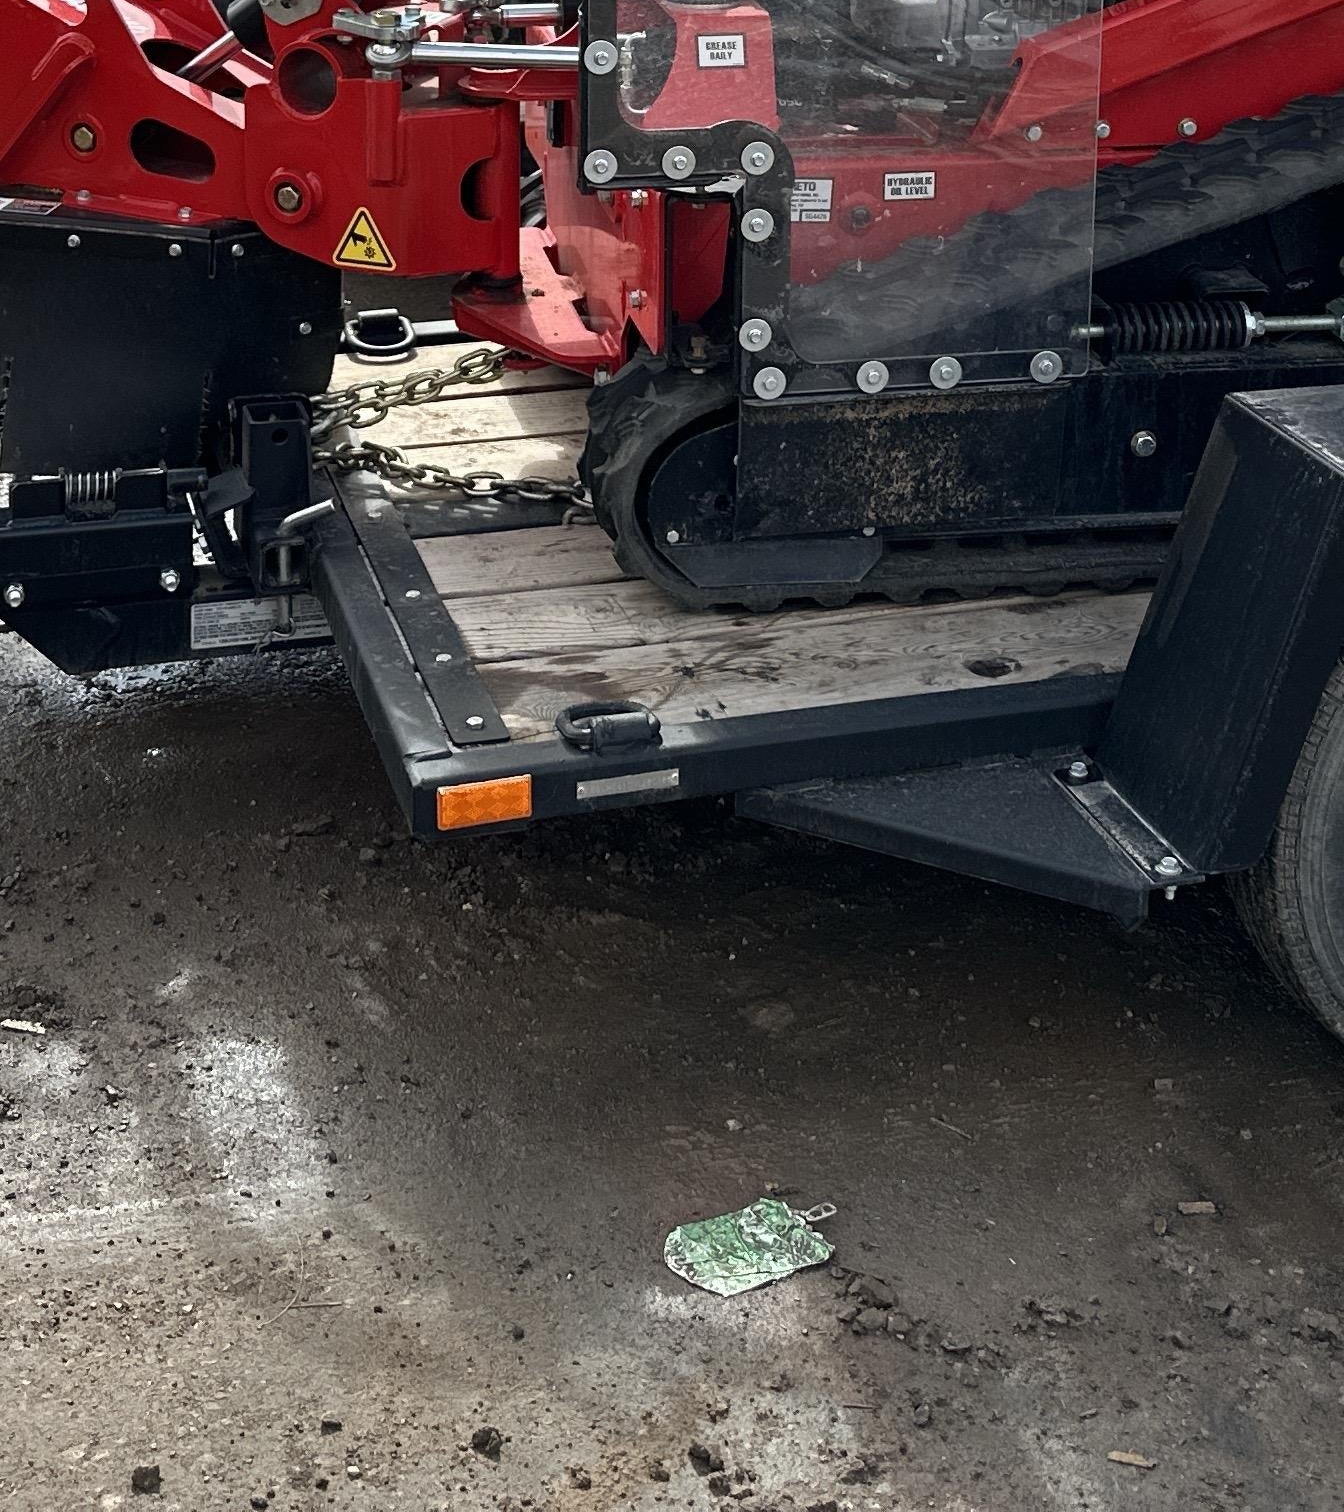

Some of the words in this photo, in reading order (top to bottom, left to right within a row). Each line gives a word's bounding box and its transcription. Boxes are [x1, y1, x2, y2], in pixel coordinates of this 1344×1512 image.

[705, 41, 737, 51] GREASE
[709, 51, 733, 61] DAILY
[887, 176, 933, 187] HYDRAULIC
[905, 186, 929, 196] LEVEL
